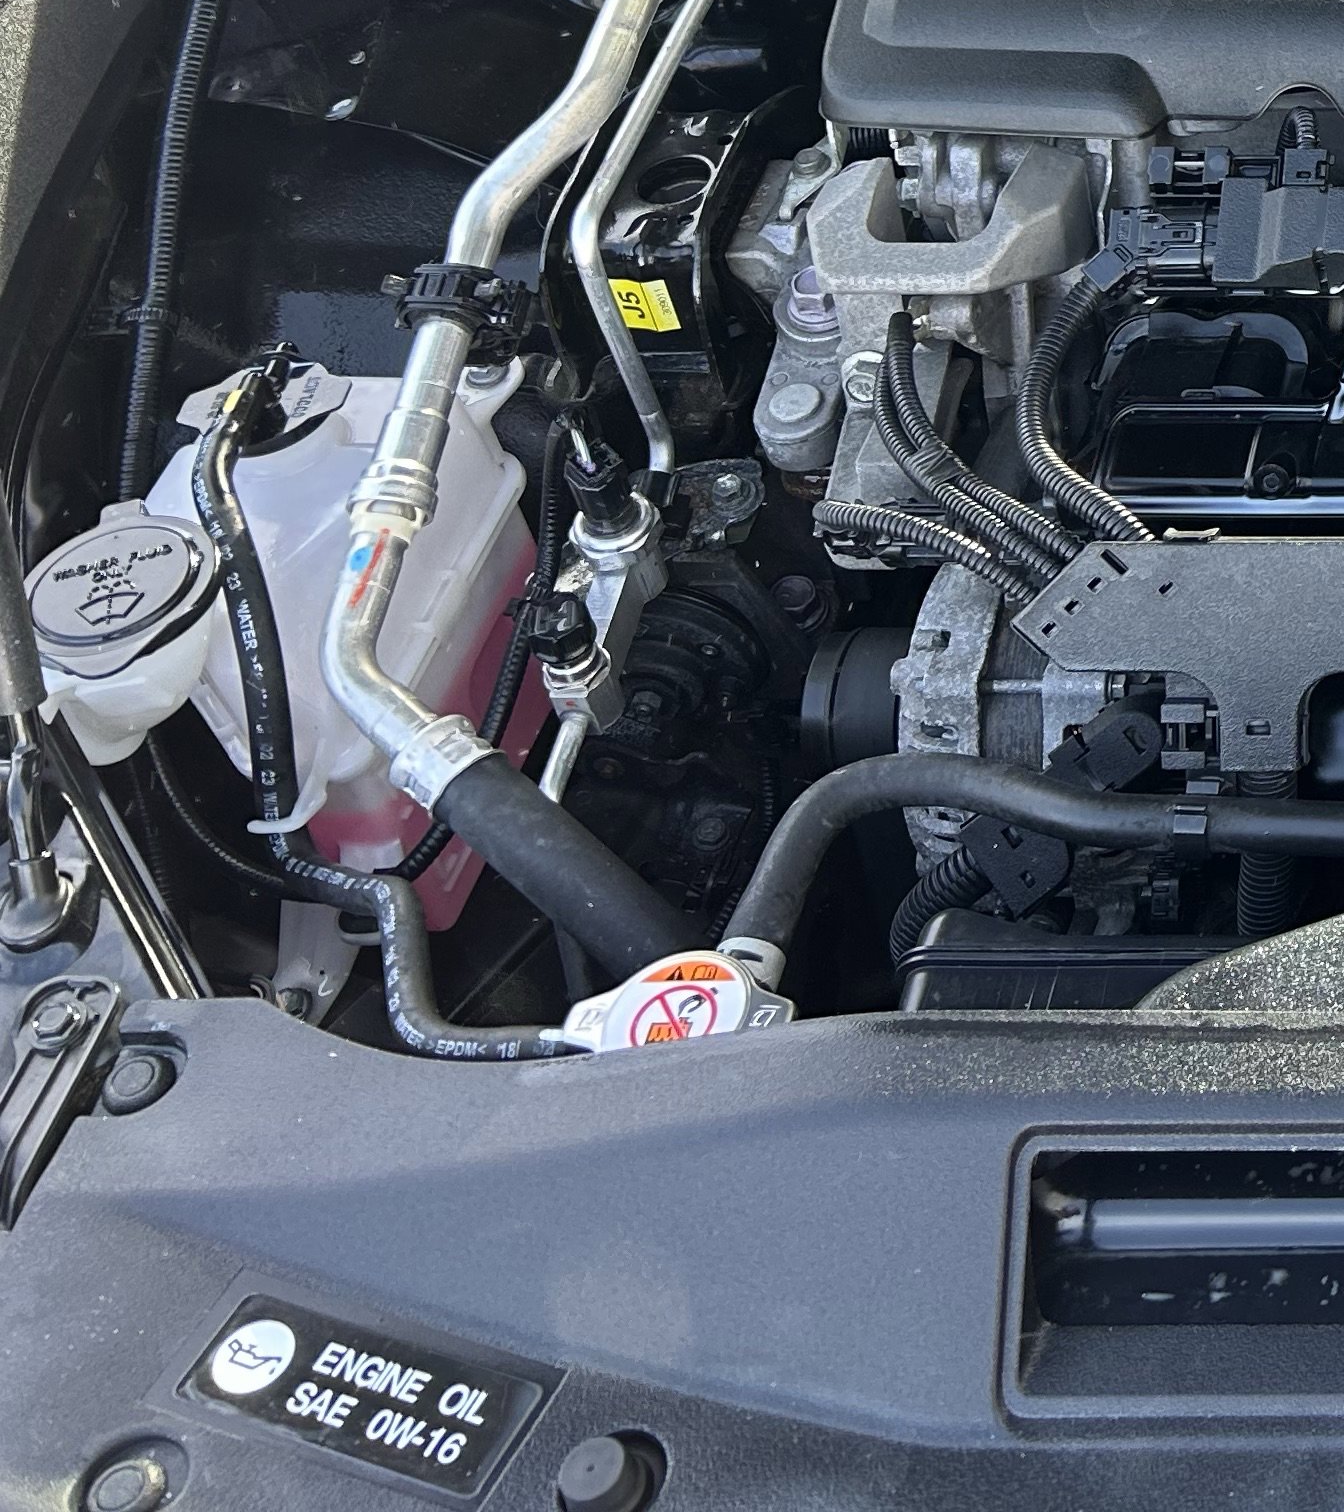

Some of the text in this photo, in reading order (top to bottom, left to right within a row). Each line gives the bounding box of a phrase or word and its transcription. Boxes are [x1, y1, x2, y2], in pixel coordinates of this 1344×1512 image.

[617, 291, 646, 319] J5
[237, 598, 259, 651] WATER
[312, 1339, 490, 1427] ENGINE OIL
[285, 1380, 468, 1467] SAE 0W-16
